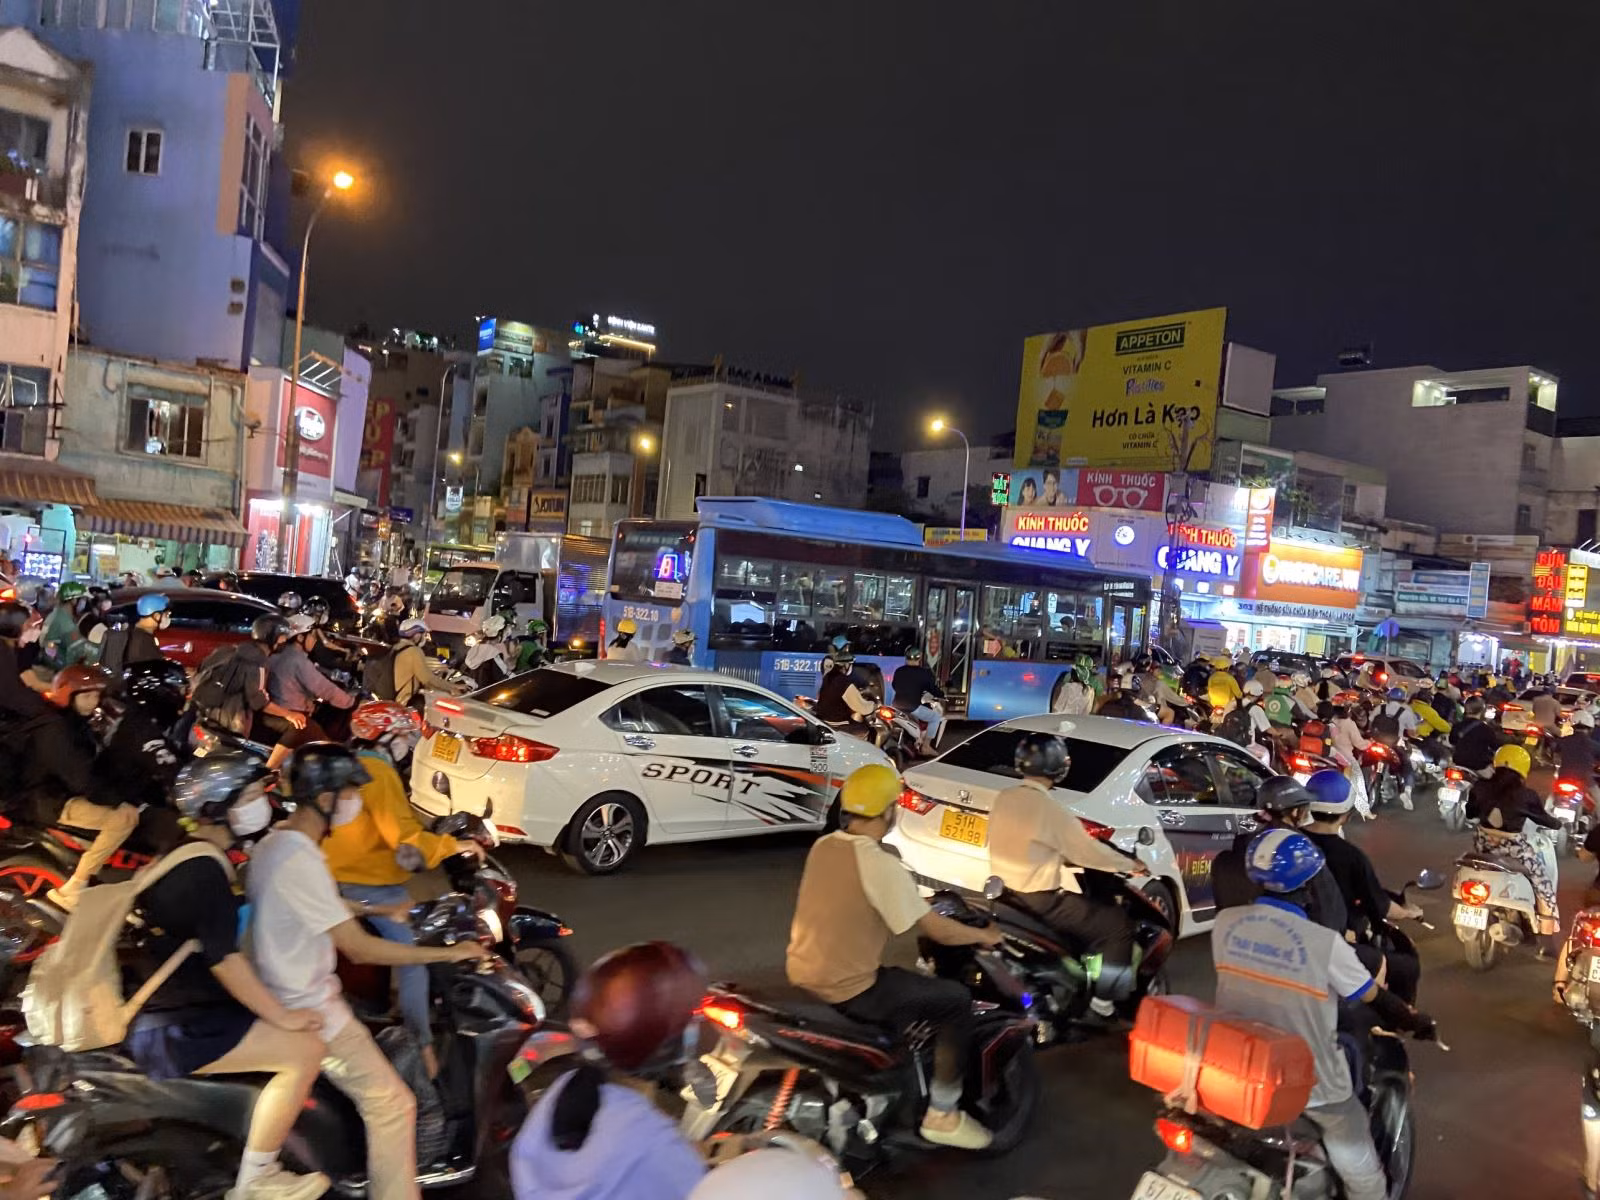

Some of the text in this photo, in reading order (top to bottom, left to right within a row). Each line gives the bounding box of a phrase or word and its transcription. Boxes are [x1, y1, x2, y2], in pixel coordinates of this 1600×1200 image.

[1120, 329, 1181, 350] APPETON
[1123, 360, 1172, 375] VITAMIN C
[1092, 409, 1128, 428] Hơn
[1134, 402, 1156, 425] Là
[1087, 471, 1156, 487] KÍNH THUỐC
[1018, 512, 1089, 532] KÍNH THUỐC
[1226, 554, 1239, 576] Y
[1538, 549, 1565, 567] BÚN
[1532, 614, 1560, 633] TÔM
[641, 761, 761, 796] SPORT
[955, 814, 976, 830] 51H
[945, 825, 981, 844] 521.98
